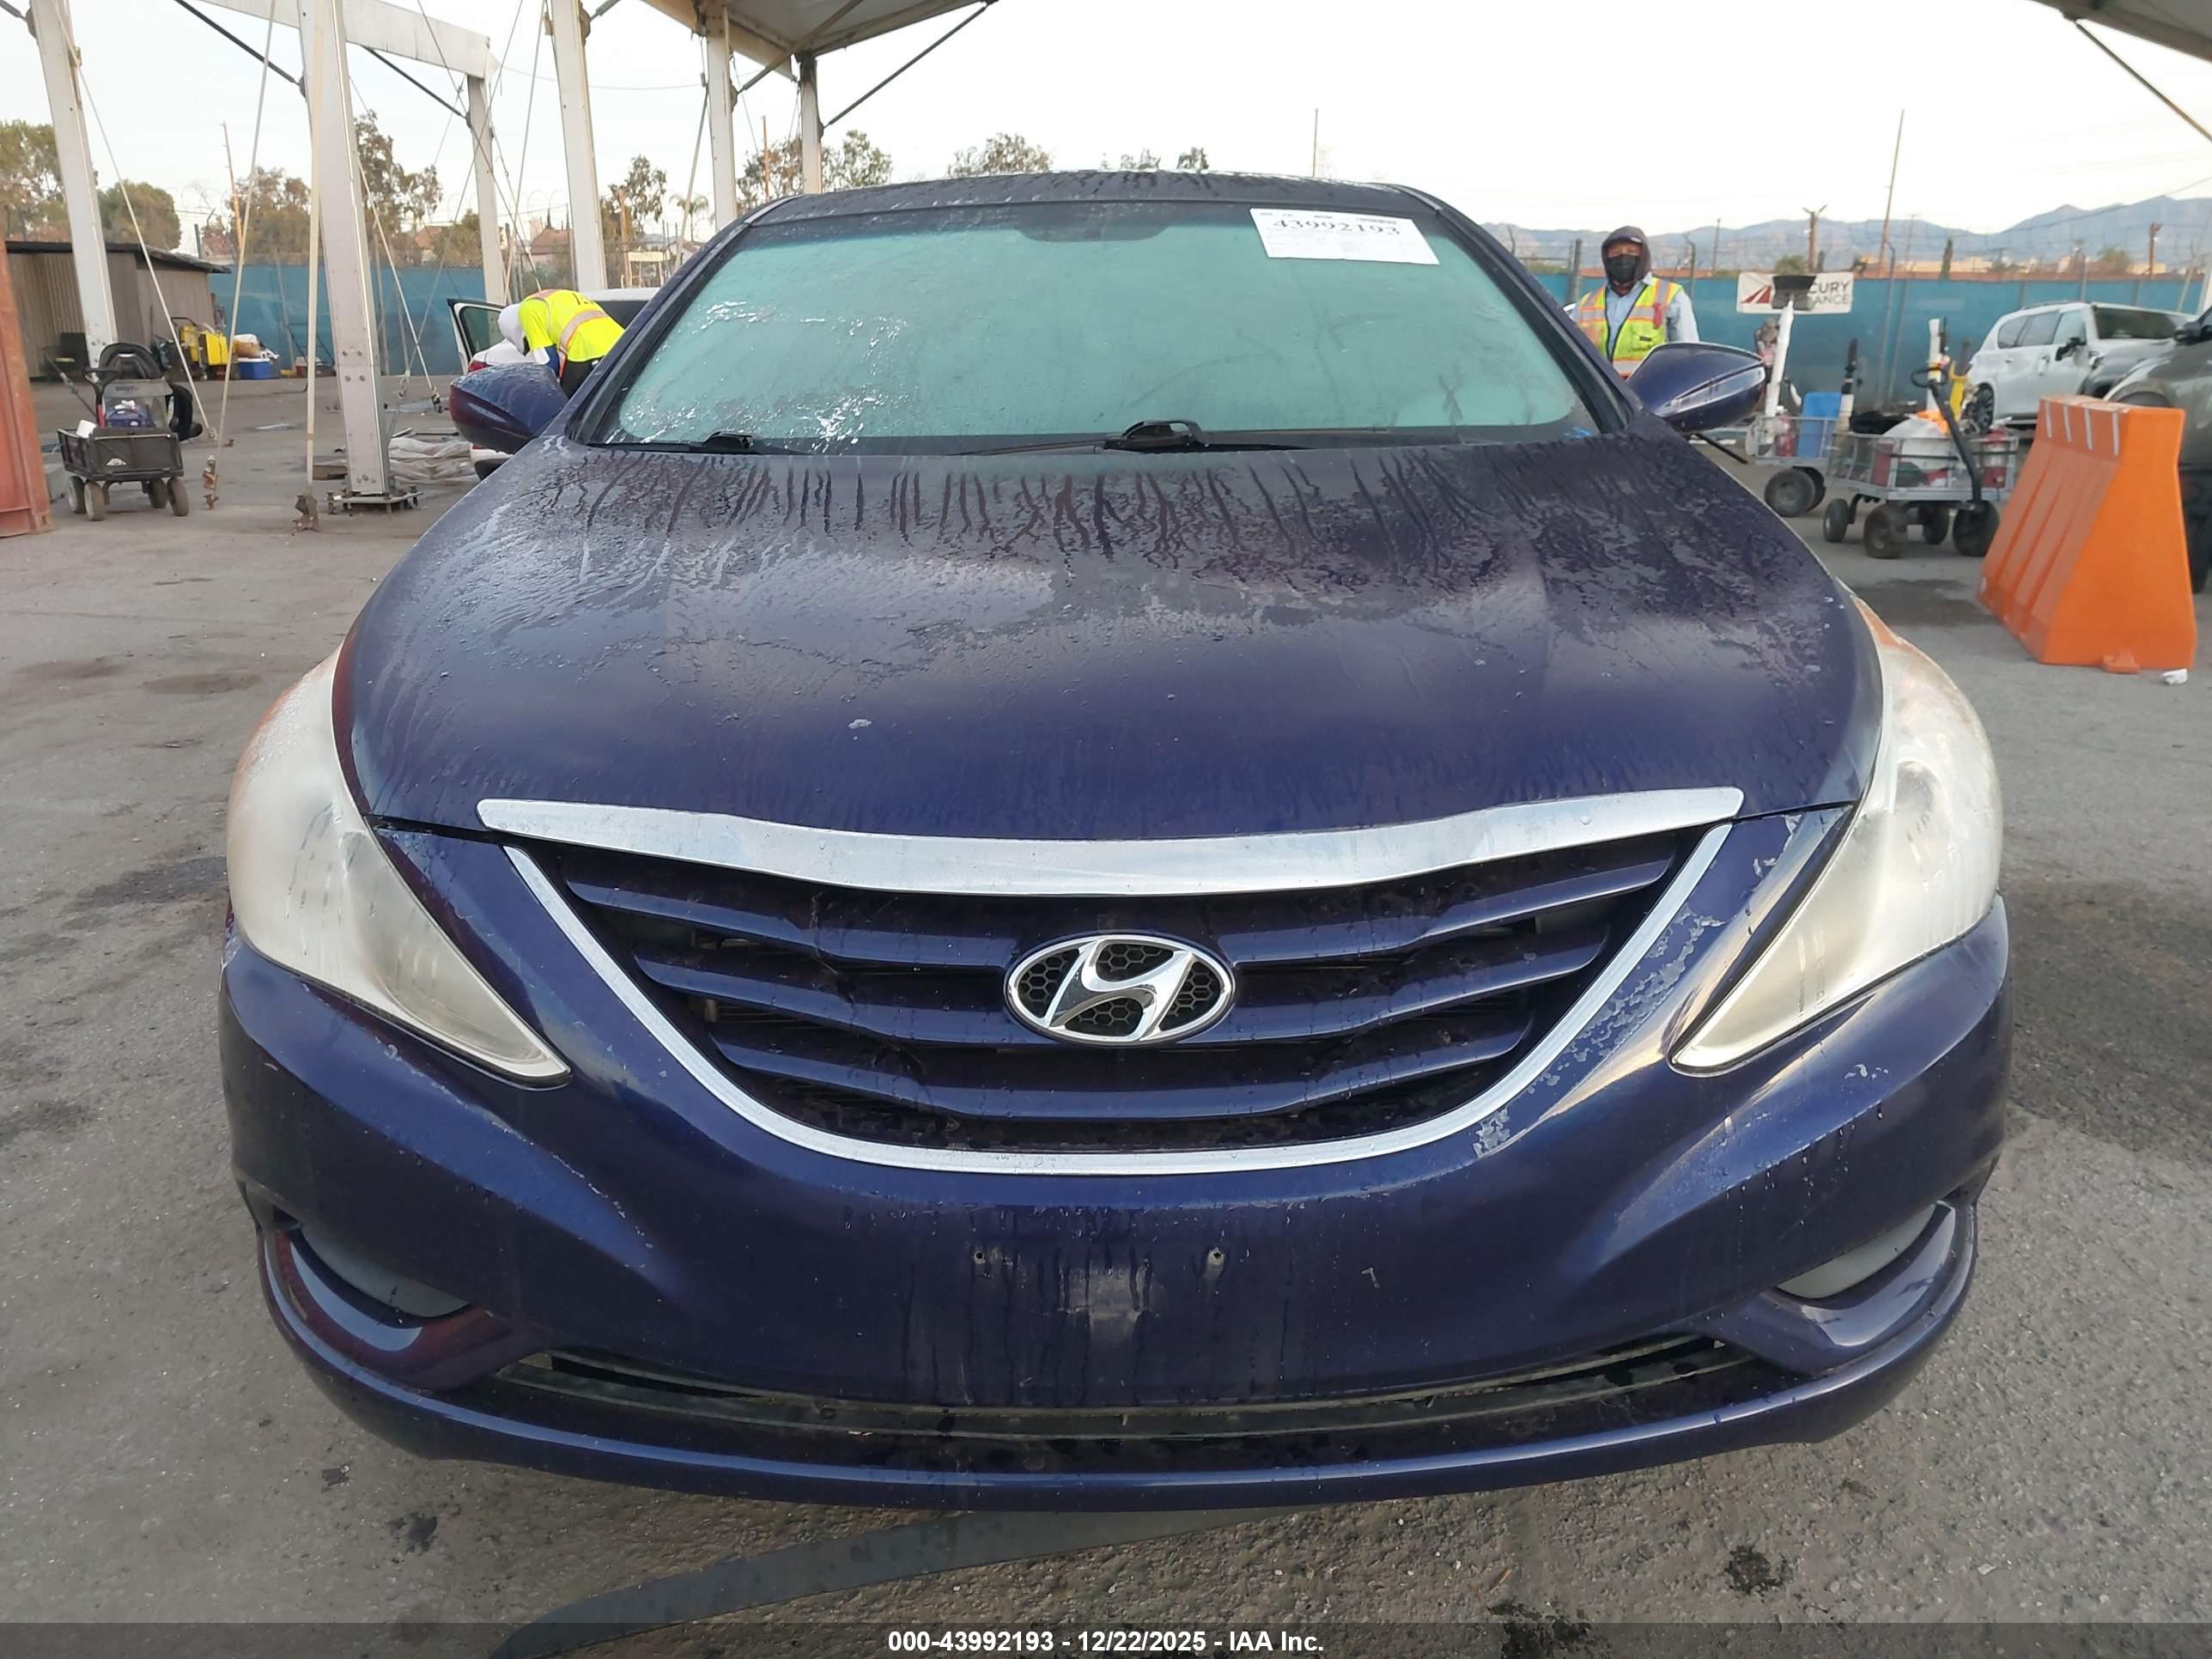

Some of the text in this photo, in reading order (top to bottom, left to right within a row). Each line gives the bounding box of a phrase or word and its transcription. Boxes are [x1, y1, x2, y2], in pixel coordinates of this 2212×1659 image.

[1273, 219, 1401, 236] 43992193
[1808, 281, 1850, 294] CURY
[1812, 295, 1849, 305] ANCE
